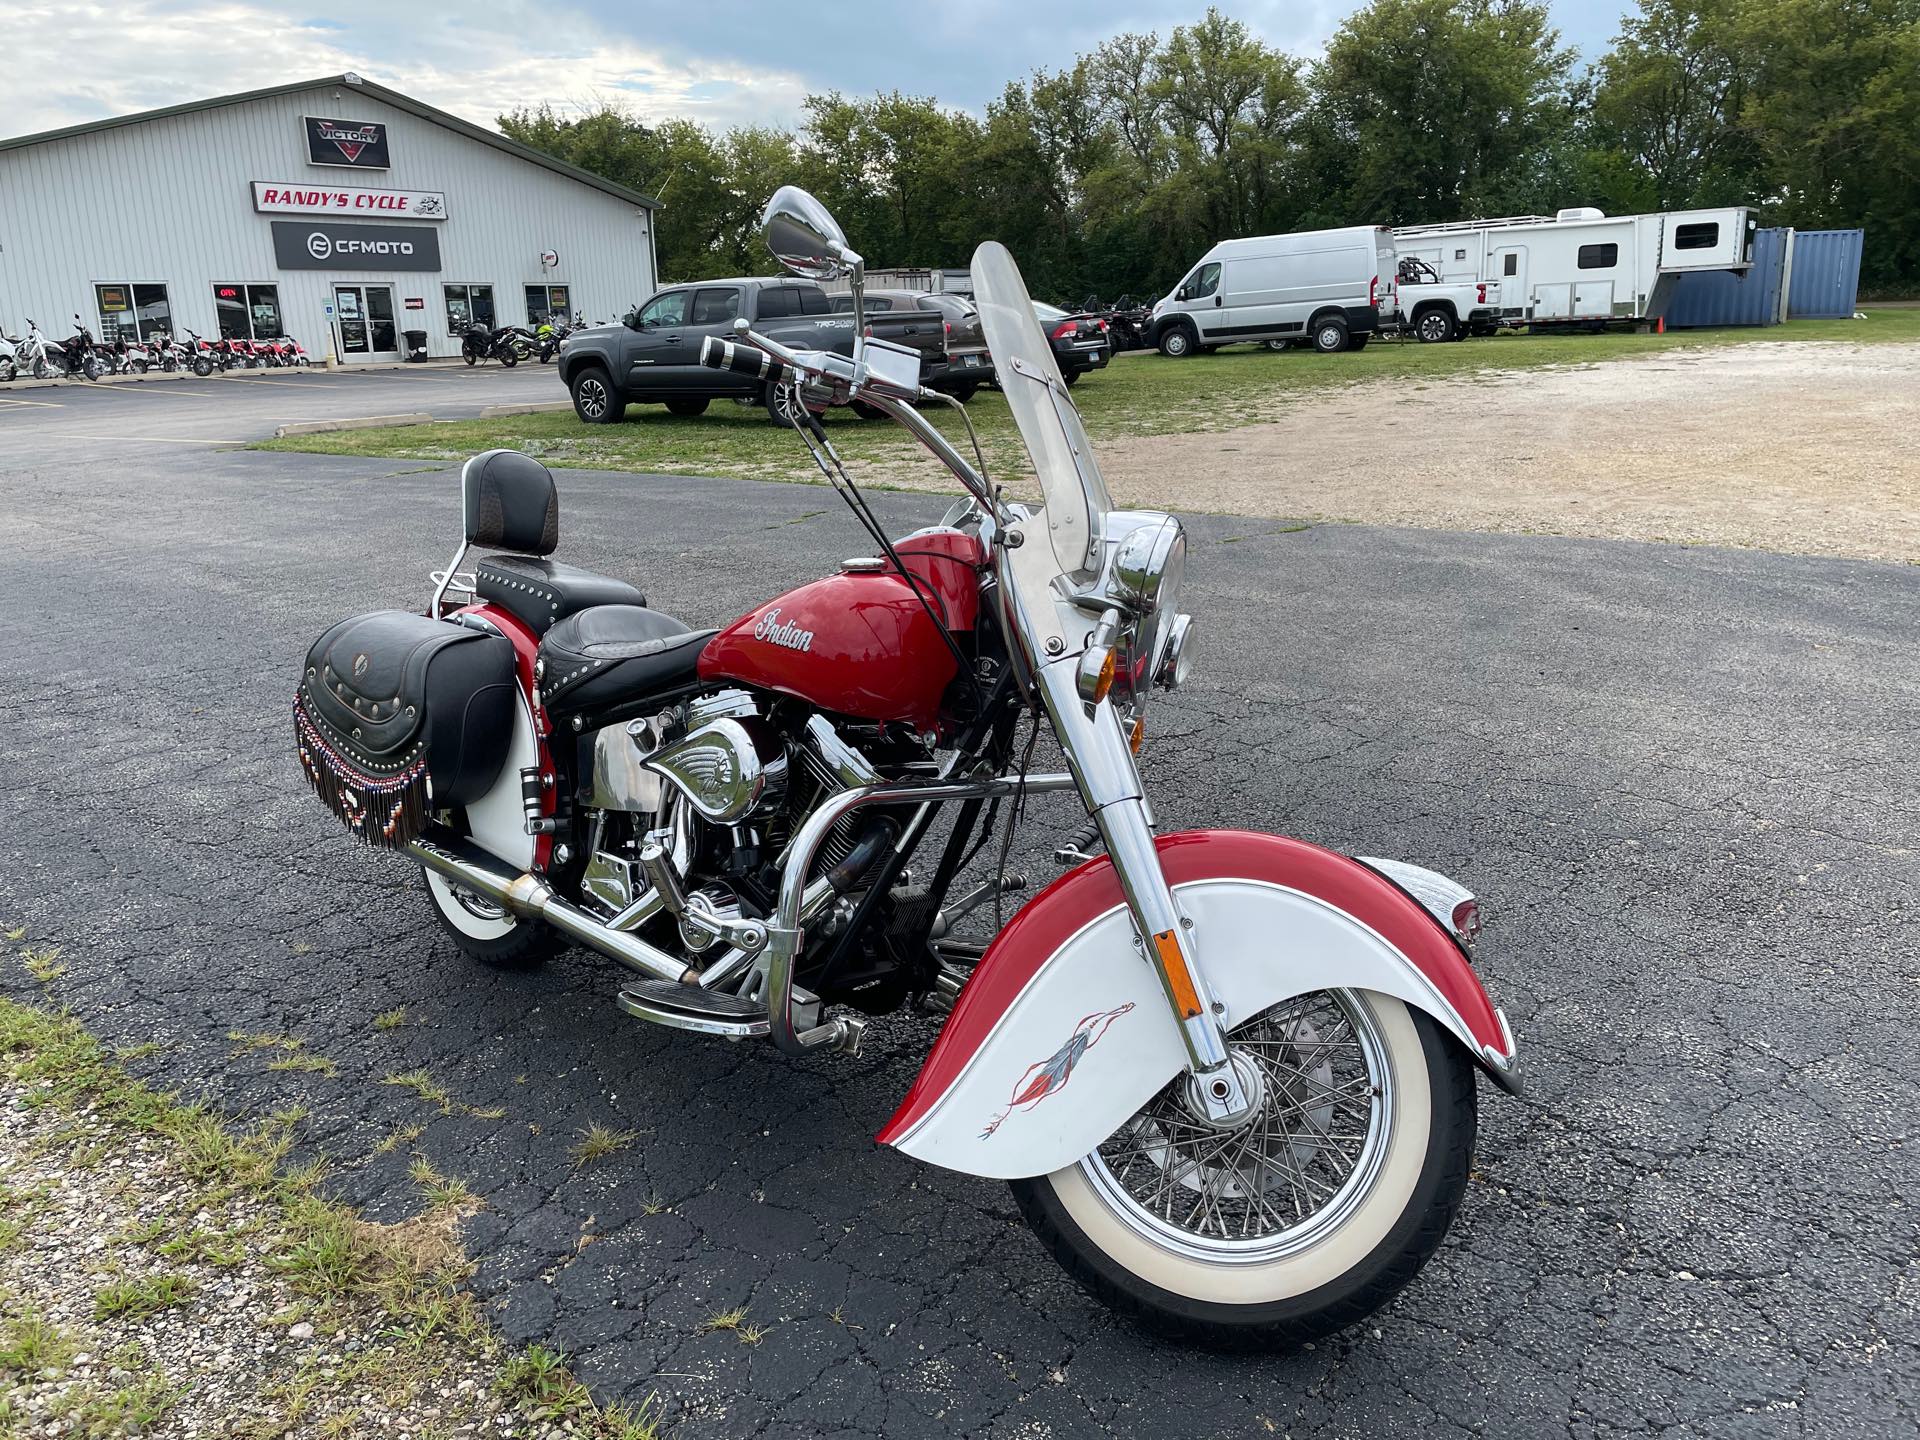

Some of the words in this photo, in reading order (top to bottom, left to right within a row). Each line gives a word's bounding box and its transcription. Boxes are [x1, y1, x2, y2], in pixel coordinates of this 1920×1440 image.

[320, 129, 378, 142] VICTORY
[263, 189, 349, 208] RANDY'S
[355, 194, 409, 210] CYCLE
[335, 240, 414, 255] CFMOTO
[220, 289, 236, 297] OPEN
[754, 608, 814, 652] Indian
